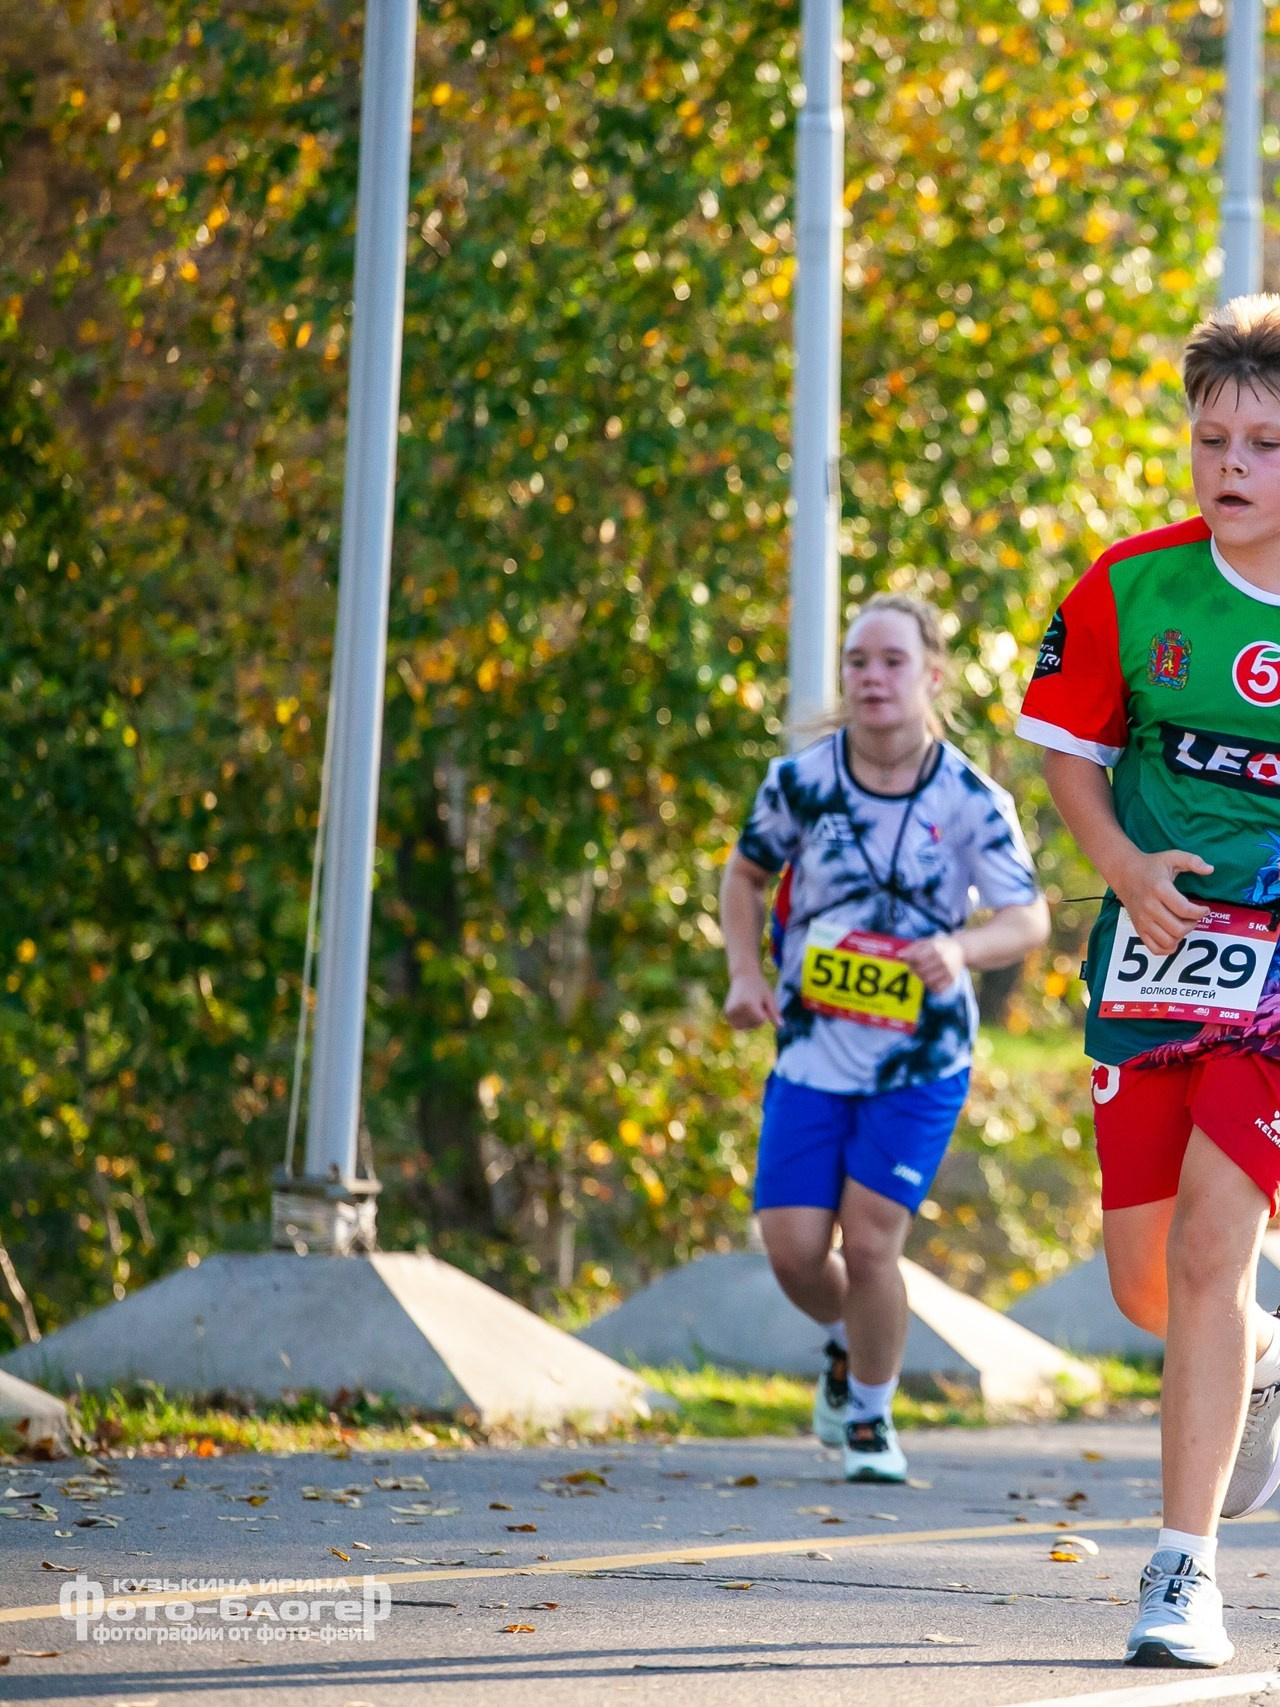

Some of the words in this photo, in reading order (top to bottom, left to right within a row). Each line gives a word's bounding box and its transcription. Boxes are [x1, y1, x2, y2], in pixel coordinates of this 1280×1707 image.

[1209, 911, 1231, 921] СКИЕ
[1117, 936, 1257, 989] 5729
[811, 953, 911, 1005] 5184
[1140, 986, 1177, 996] ВОЛКОВ
[1179, 988, 1217, 1000] СЕРГЕЙ
[1219, 1010, 1240, 1020] 2026
